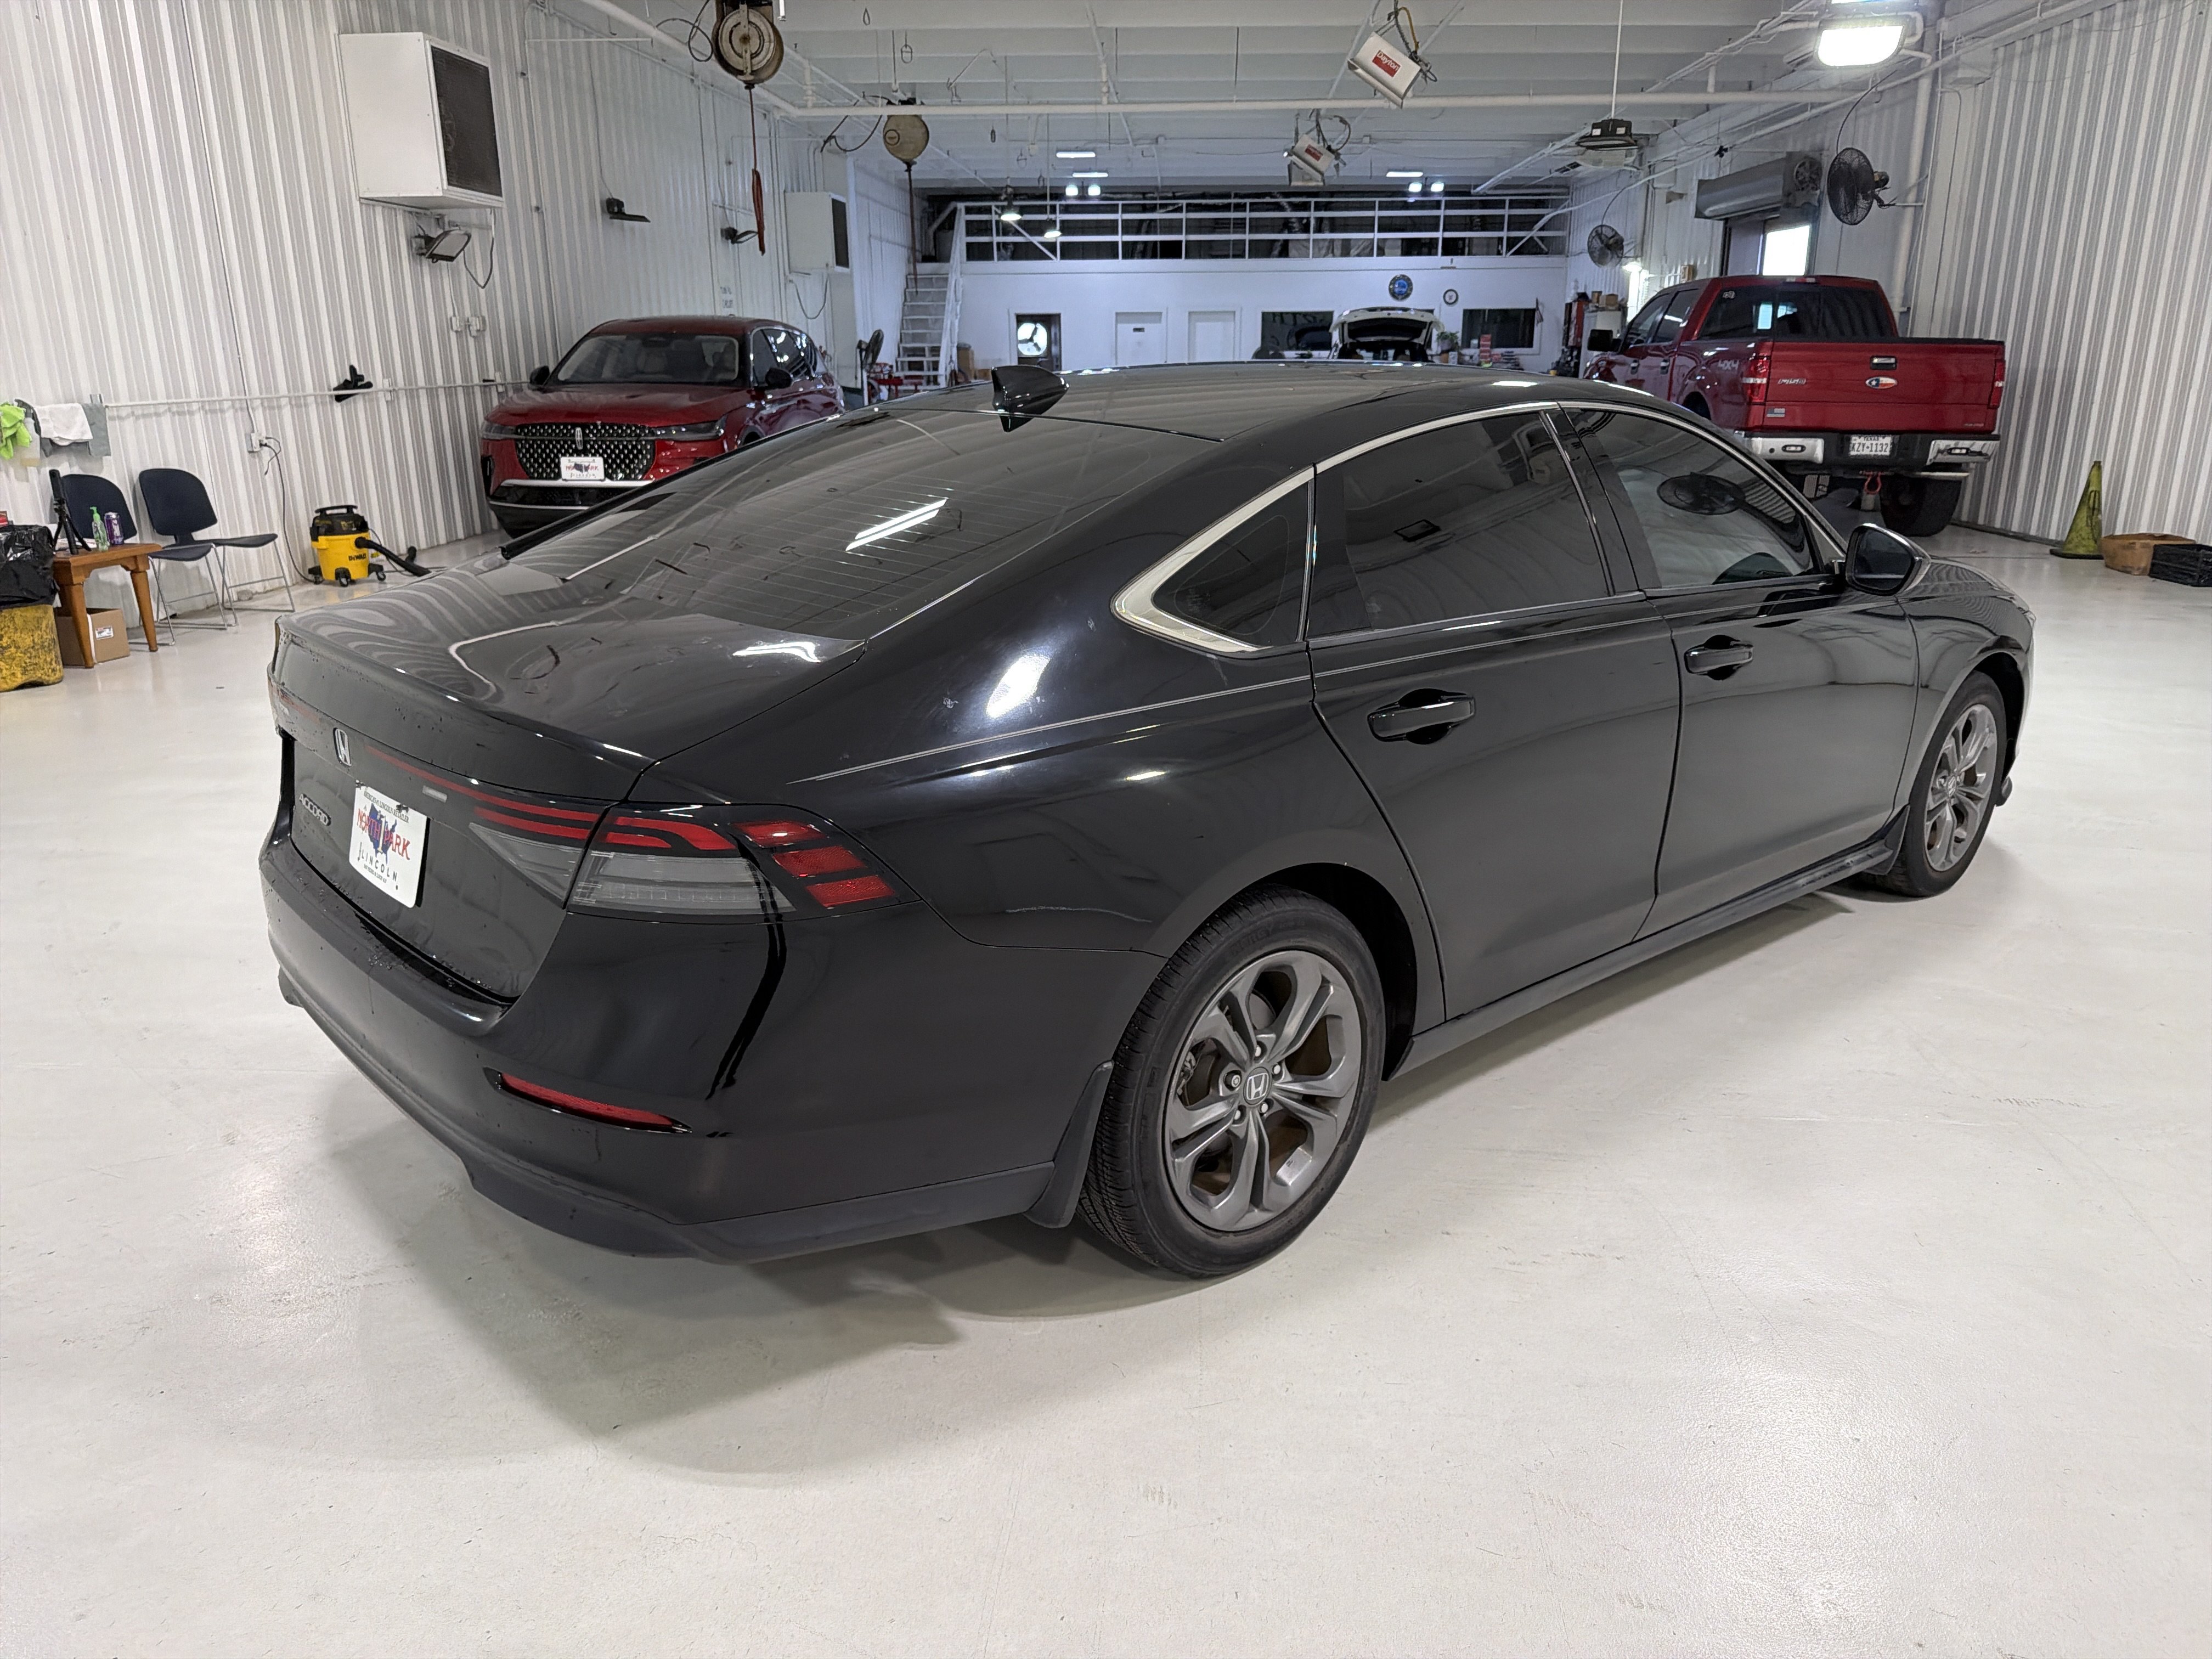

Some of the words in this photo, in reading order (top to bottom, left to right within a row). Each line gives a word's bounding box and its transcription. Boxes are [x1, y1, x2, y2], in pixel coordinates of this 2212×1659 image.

[1376, 51, 1399, 71] Dayton
[298, 794, 330, 826] ACCORD
[379, 800, 393, 815] LINCOLN
[357, 808, 382, 840] NORTH
[384, 827, 410, 861] PARK
[362, 849, 397, 882] LINCOLN
